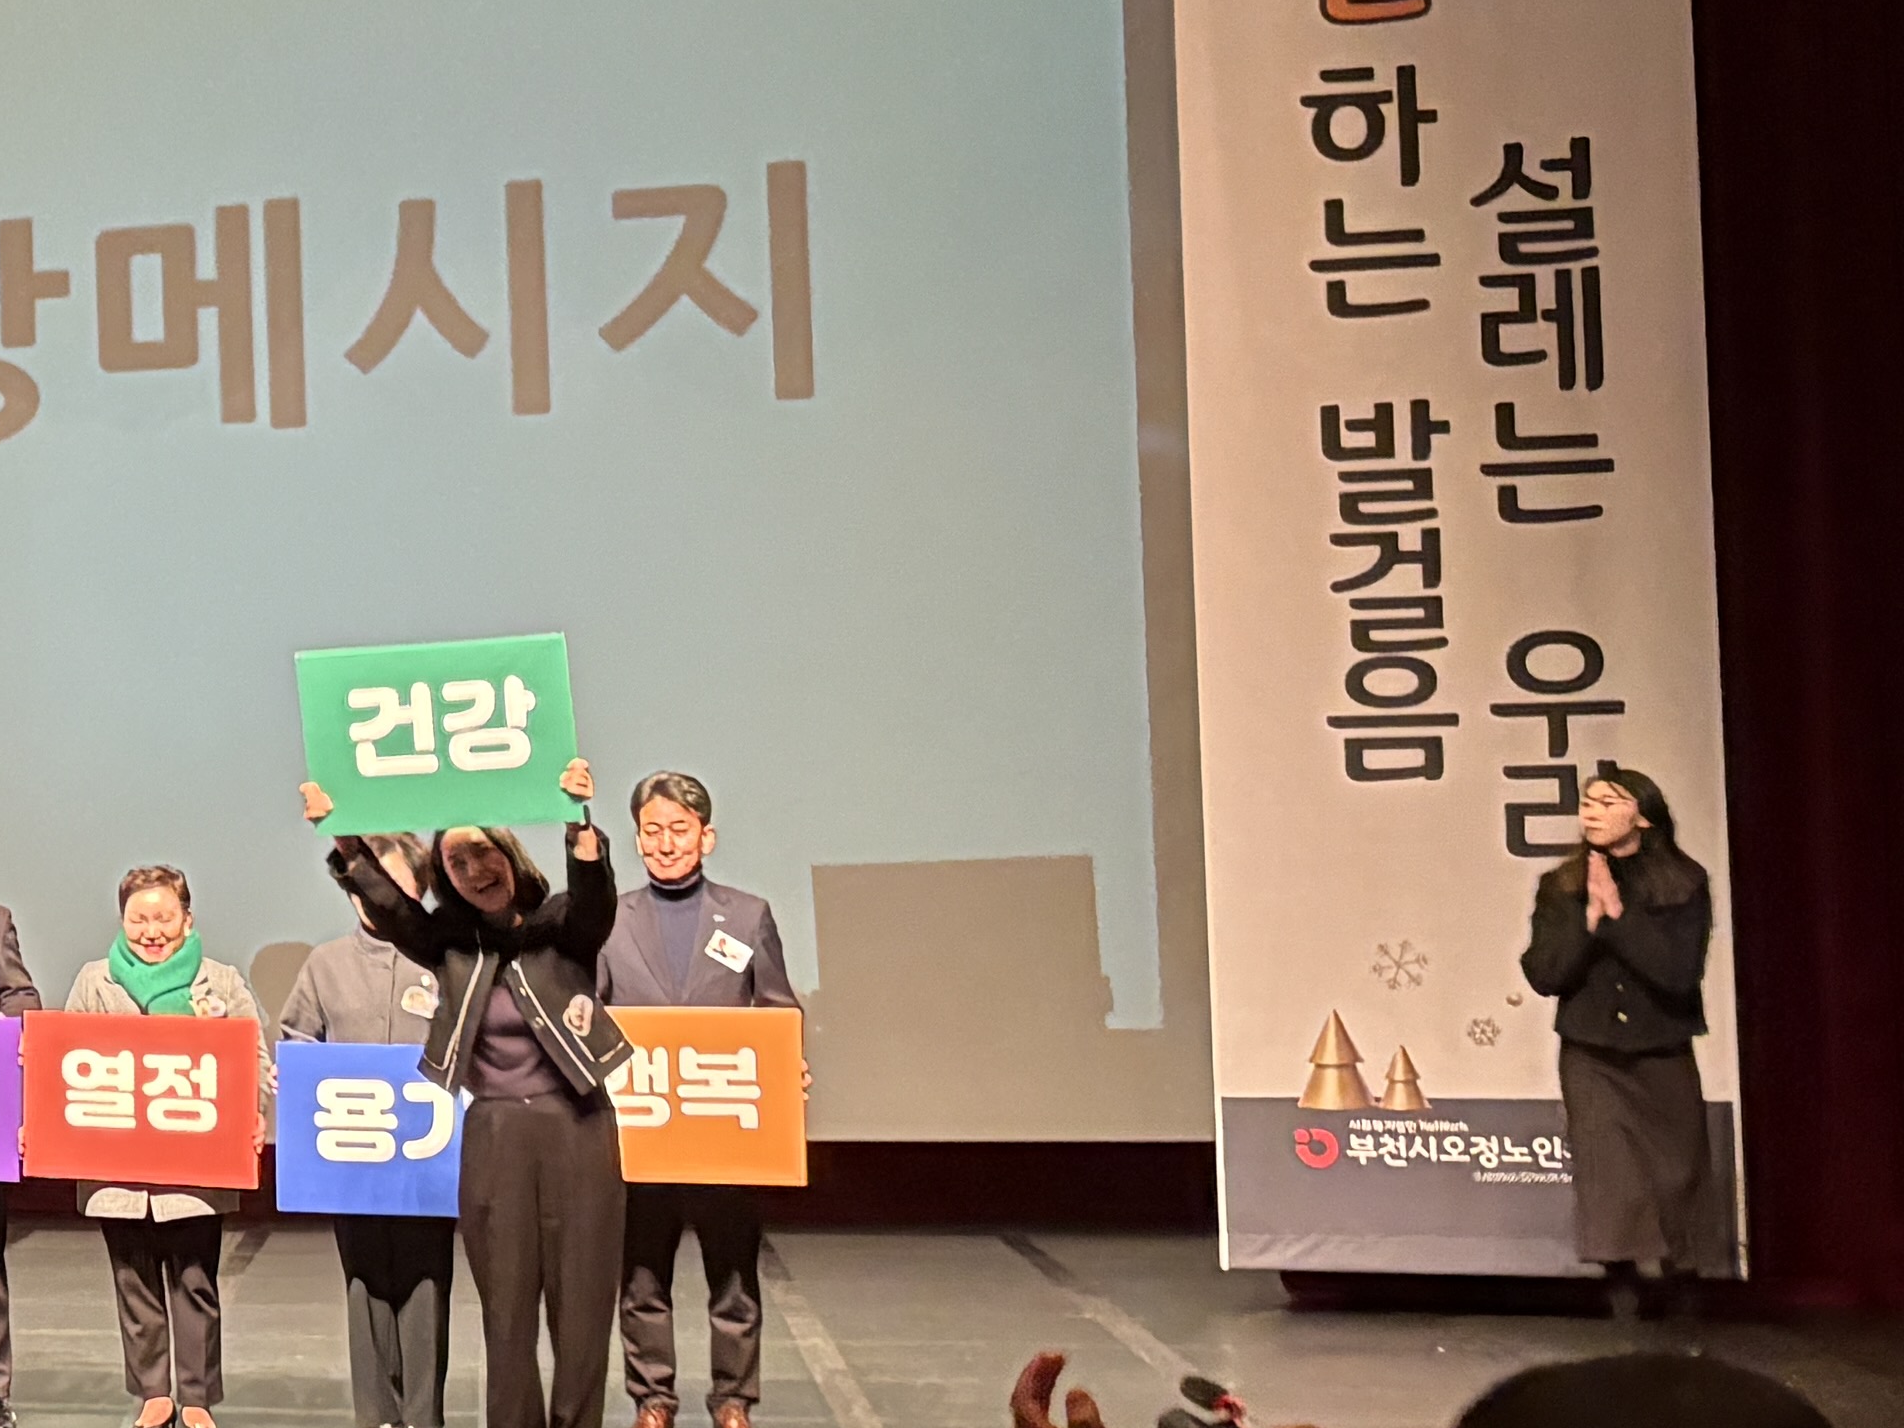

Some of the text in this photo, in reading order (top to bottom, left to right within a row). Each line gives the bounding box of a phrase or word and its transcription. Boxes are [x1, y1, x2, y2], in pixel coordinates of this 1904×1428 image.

[1469, 136, 1616, 525] 설레는
[1319, 398, 1460, 783] 발걸음
[345, 674, 537, 778] 건강
[60, 1047, 219, 1133] 열정
[1346, 1133, 1572, 1169] 부천시오정노인
